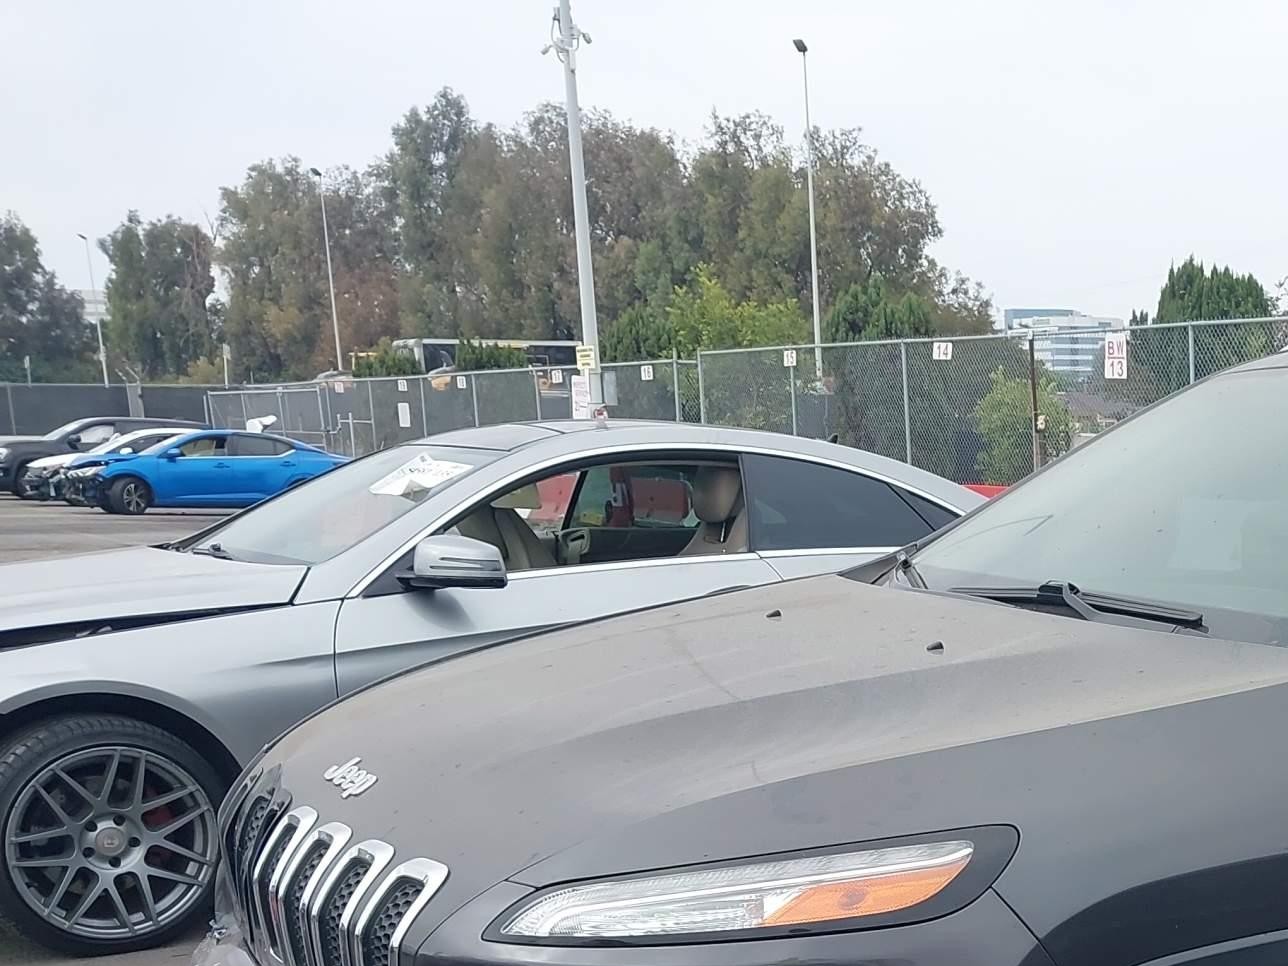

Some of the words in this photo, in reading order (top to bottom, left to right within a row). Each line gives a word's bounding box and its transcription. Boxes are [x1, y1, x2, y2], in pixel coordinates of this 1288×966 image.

[786, 352, 795, 365] 15
[936, 344, 949, 359] 14
[643, 366, 652, 380] 16
[1110, 361, 1125, 377] 13
[323, 756, 379, 800] Jeep
